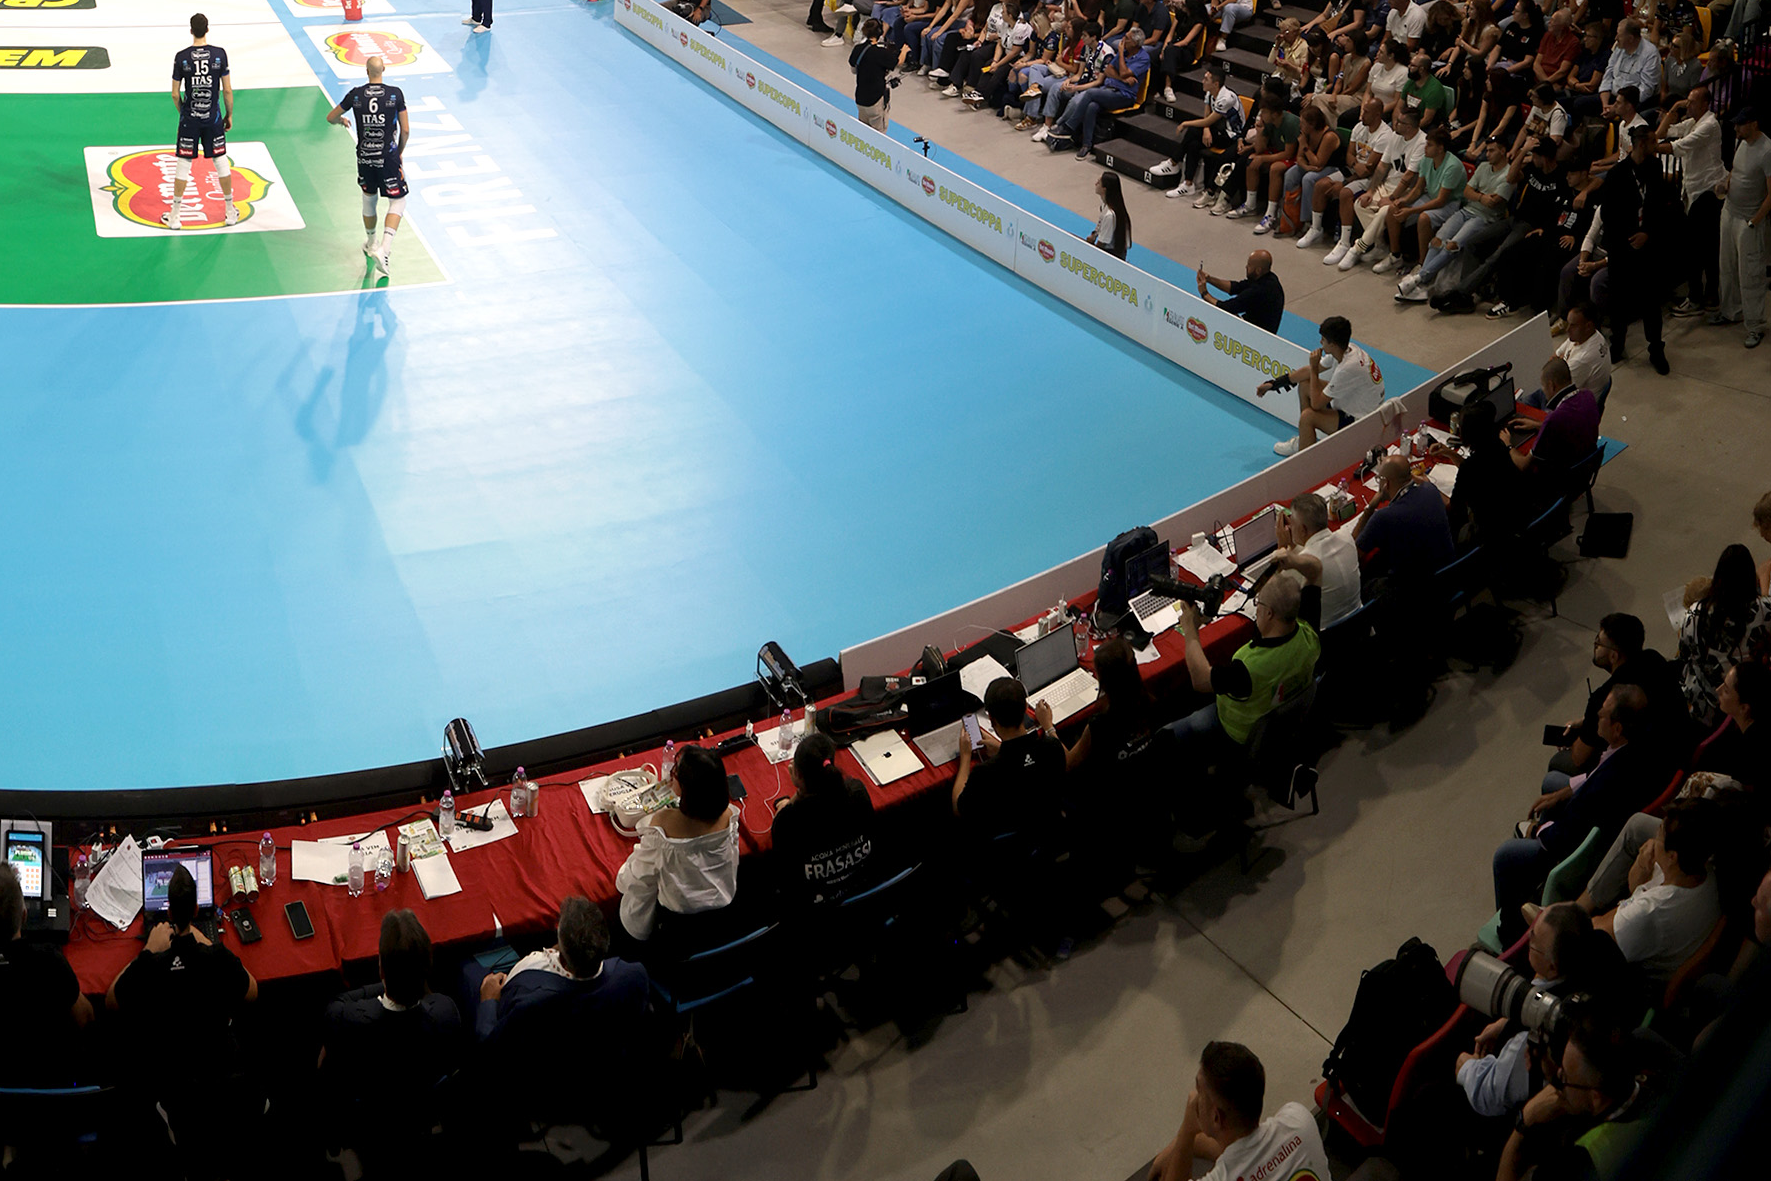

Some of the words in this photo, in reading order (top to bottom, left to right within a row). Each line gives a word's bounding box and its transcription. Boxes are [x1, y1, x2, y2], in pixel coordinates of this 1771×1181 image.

[632, 2, 664, 31] SUPERCOPPA
[193, 60, 209, 76] 15
[690, 38, 727, 71] SUPERCOPPA
[191, 75, 213, 85] ITAS
[368, 97, 379, 113] 6
[758, 79, 801, 117] SUPERCOPPA
[362, 114, 386, 124] ITAS
[840, 128, 893, 171] SUPERCOPPA
[1106, 156, 1114, 167] A
[938, 185, 1003, 235] SUPERCOPPA
[1059, 251, 1139, 308] SUPERCOPPA
